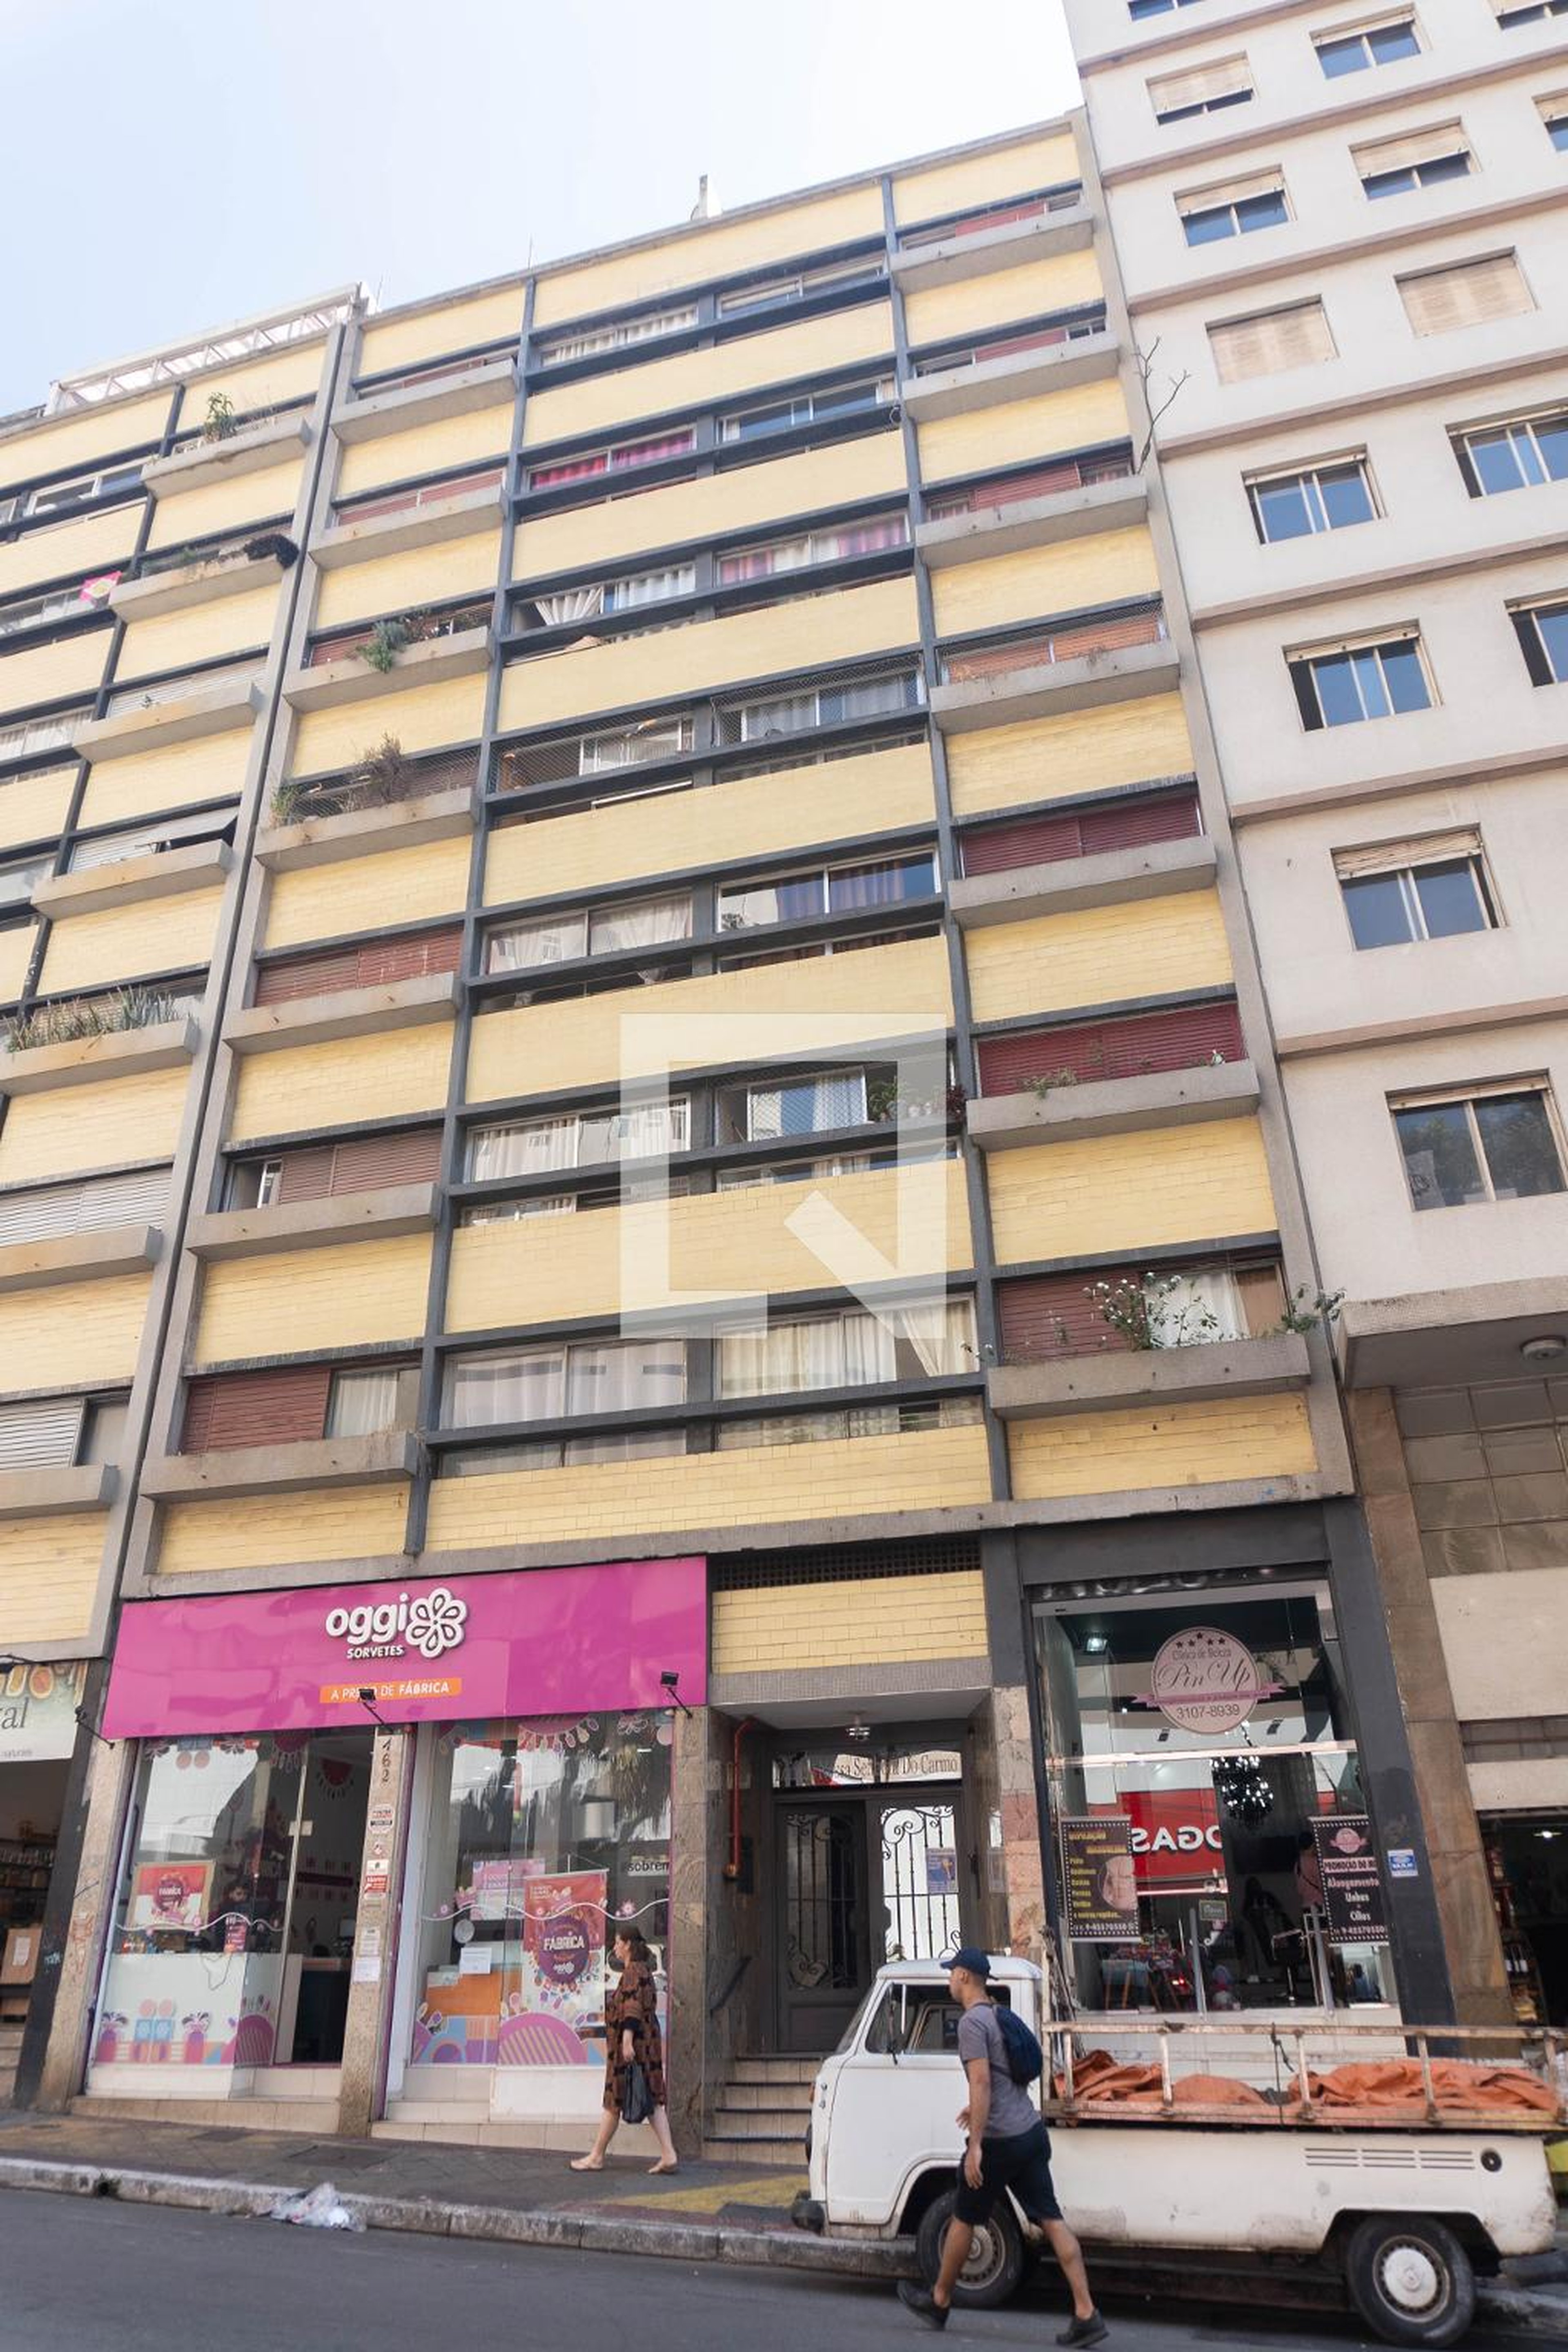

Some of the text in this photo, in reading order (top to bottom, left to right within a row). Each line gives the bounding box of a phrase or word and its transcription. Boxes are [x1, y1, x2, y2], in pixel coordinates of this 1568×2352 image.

[325, 1592, 408, 1645] oggi
[346, 1645, 405, 1659] SORVETES
[1157, 1658, 1250, 1691] Pin Up
[330, 1680, 450, 1700] A PREO DE FÁBRICA
[0, 1696, 29, 1730] al
[921, 1755, 958, 1773] Carmo
[543, 1935, 585, 1951] FÁBRICA
